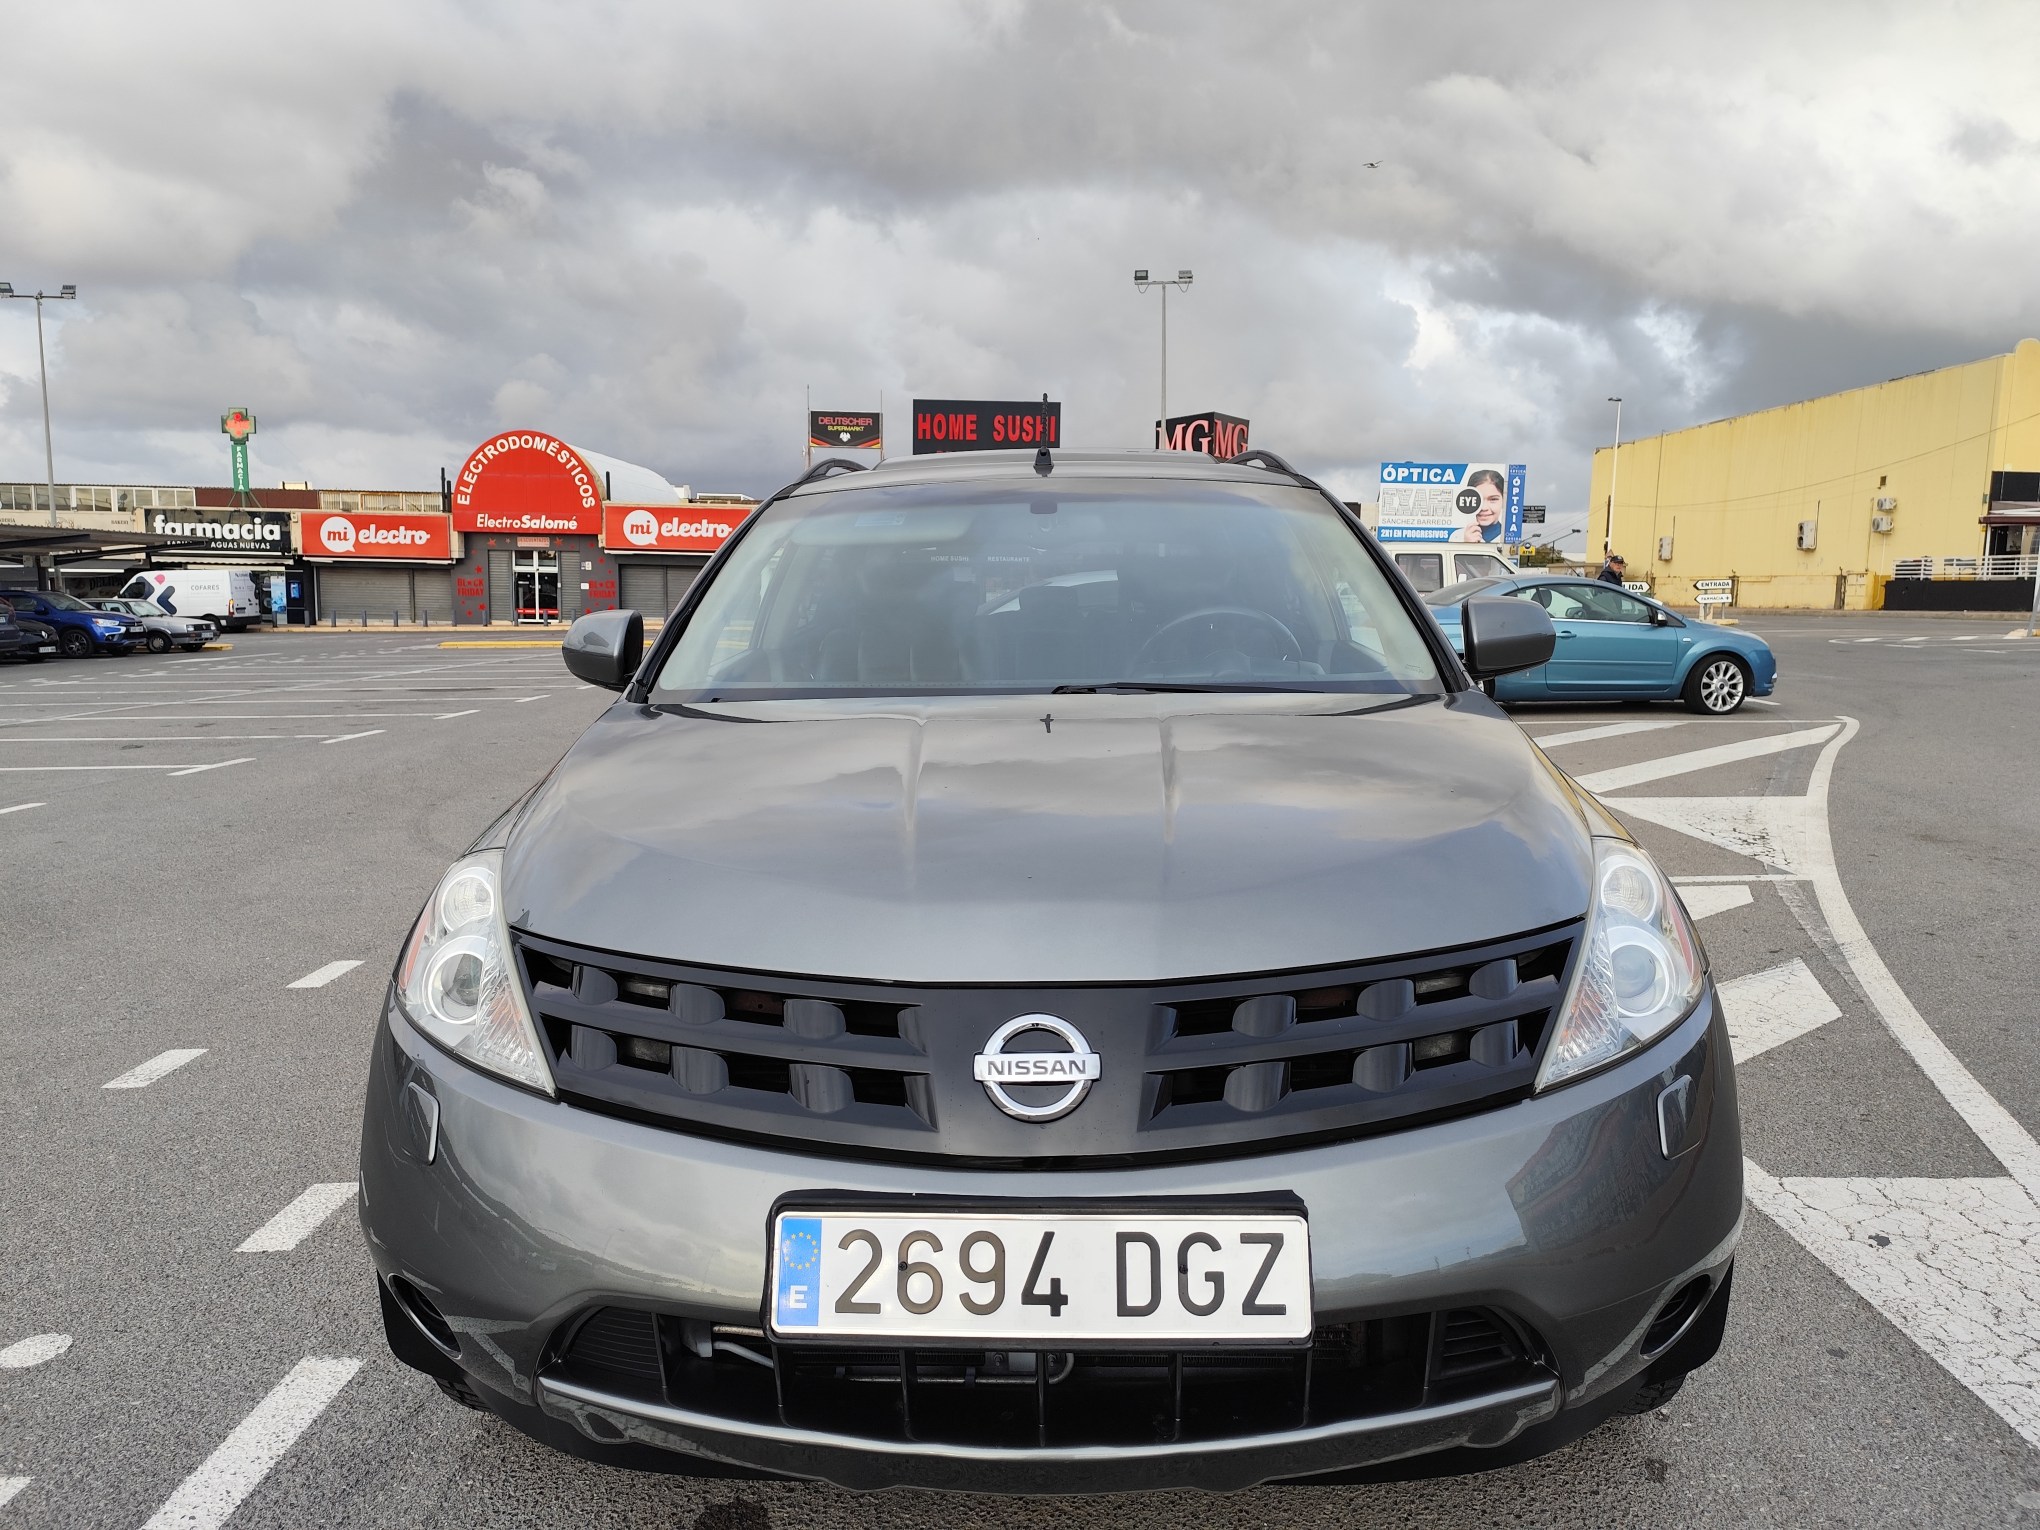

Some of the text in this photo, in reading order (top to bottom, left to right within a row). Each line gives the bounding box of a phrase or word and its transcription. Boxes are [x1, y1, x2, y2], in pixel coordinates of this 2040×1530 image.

[818, 416, 873, 426] DEUTSCHER
[917, 413, 1056, 442] HOME SUSHI
[1156, 419, 1212, 454] MG
[1213, 419, 1248, 460] MG
[236, 446, 244, 490] FARMACIA
[457, 435, 596, 509] ELECTRODOMÉSTICOS
[1382, 464, 1456, 483] ÓPTICA
[1459, 496, 1477, 507] EYE
[153, 514, 281, 541] farmacia
[476, 513, 578, 530] ElectroSalomé
[630, 517, 732, 538] mi electro
[327, 523, 430, 545] mi electro
[1381, 528, 1449, 539] 2X1 EN PROGRESIVOS
[210, 541, 271, 550] AGUAS NUEVAS
[457, 587, 484, 597] FRIDAY
[986, 1059, 1088, 1077] NISSAN
[834, 1229, 1288, 1318] 2694 DGZ
[789, 1285, 809, 1309] E
